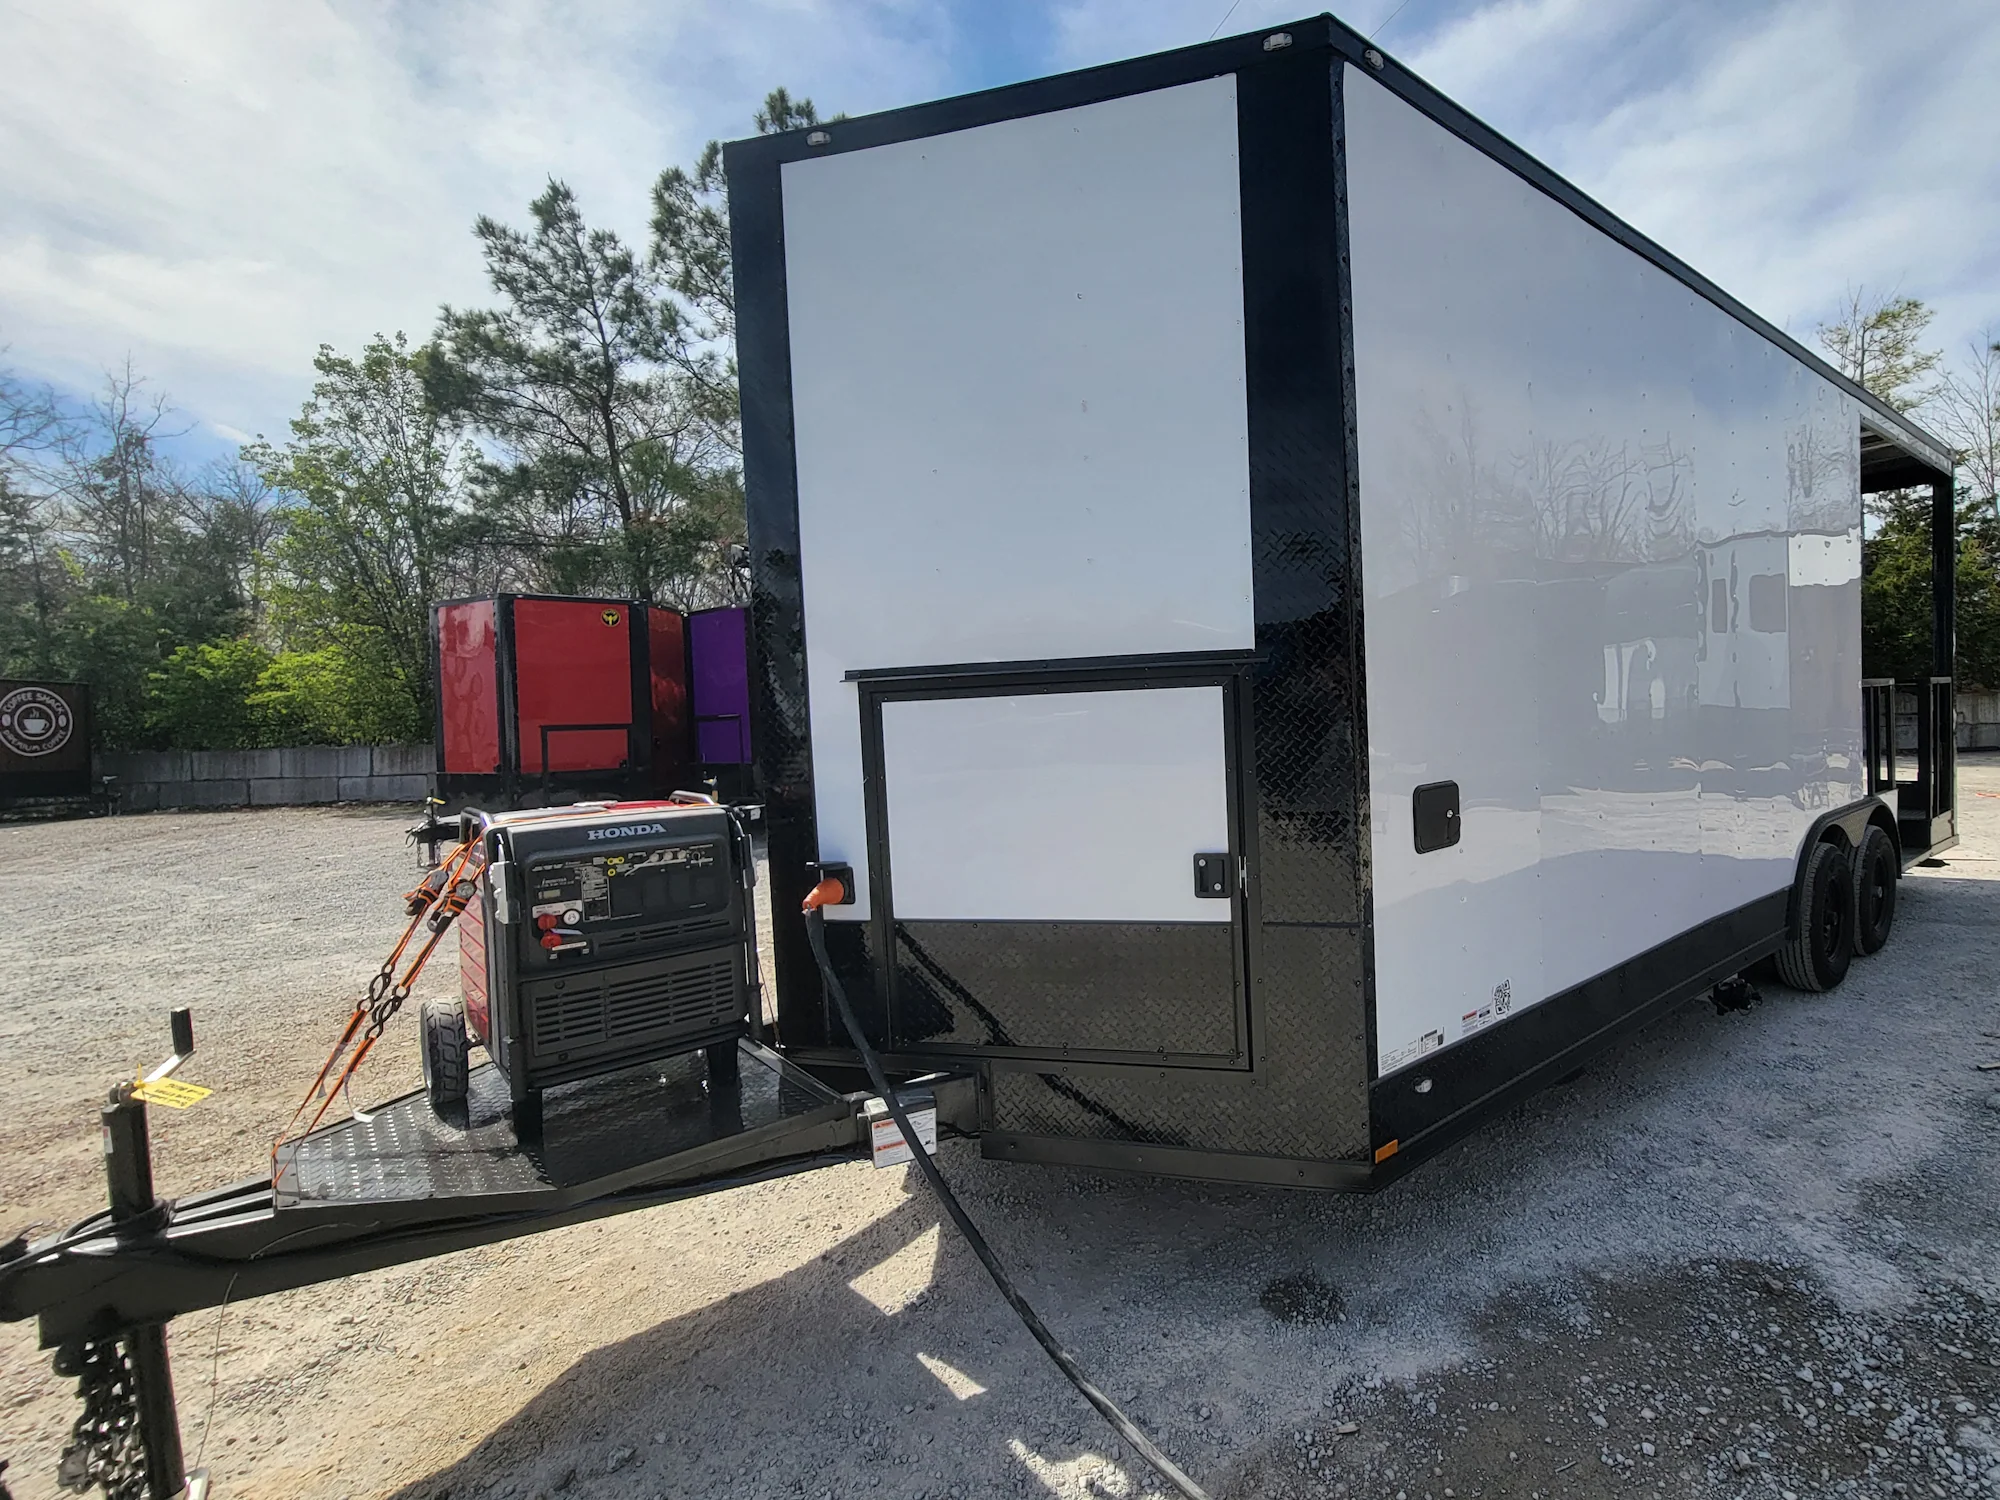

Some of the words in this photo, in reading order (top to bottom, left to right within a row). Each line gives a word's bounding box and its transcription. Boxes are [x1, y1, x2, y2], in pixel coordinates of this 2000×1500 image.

[3, 692, 33, 712] COFFEE
[35, 692, 65, 714] SHACK
[3, 729, 40, 751] PREMIUM
[588, 823, 667, 841] HONDA
